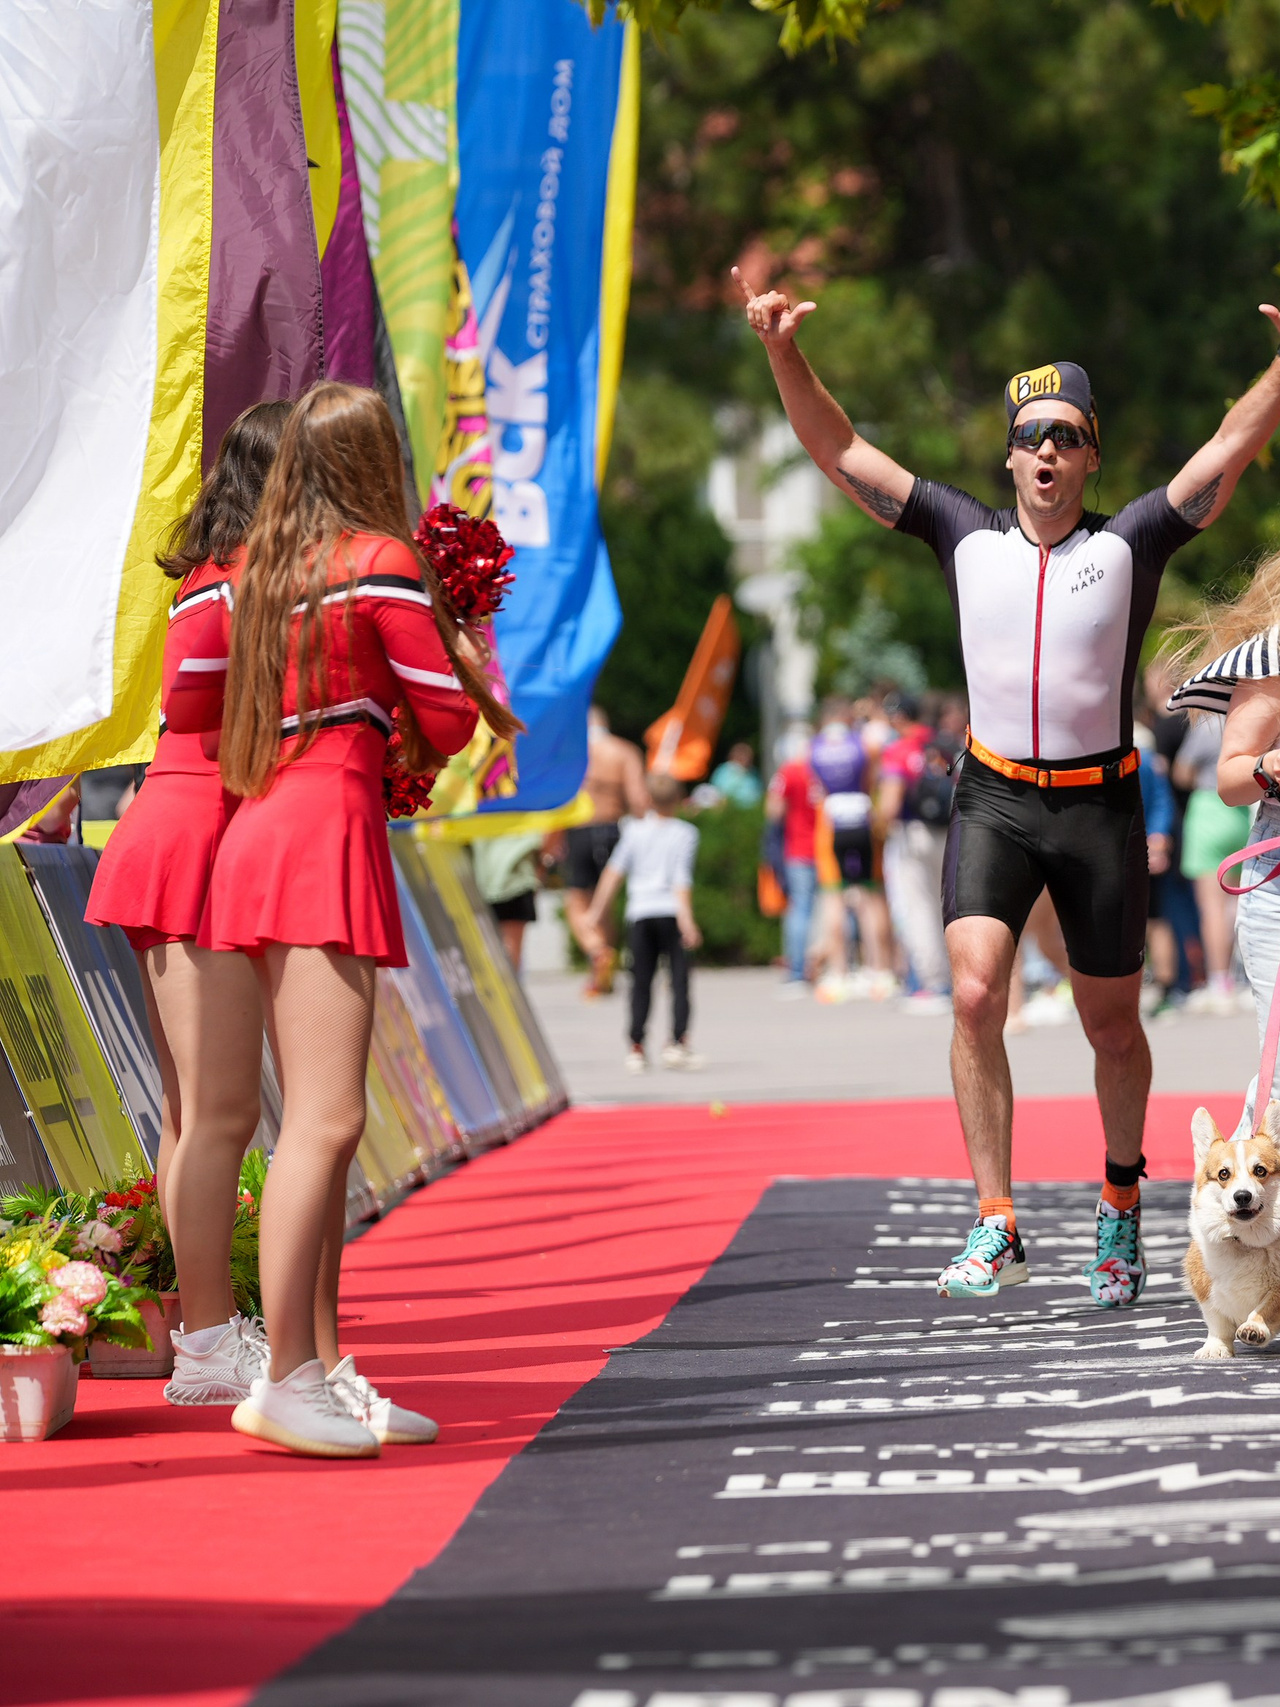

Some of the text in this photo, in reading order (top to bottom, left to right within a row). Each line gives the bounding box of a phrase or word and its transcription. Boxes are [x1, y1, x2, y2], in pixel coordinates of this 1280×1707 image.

[549, 58, 575, 143] ДОМ
[486, 346, 551, 547] ВСК
[1071, 569, 1104, 594] HARD
[1077, 562, 1096, 580] TRI
[765, 1389, 1080, 1412] IRON
[724, 1466, 1081, 1491] IRON
[664, 1562, 1078, 1597] IRON
